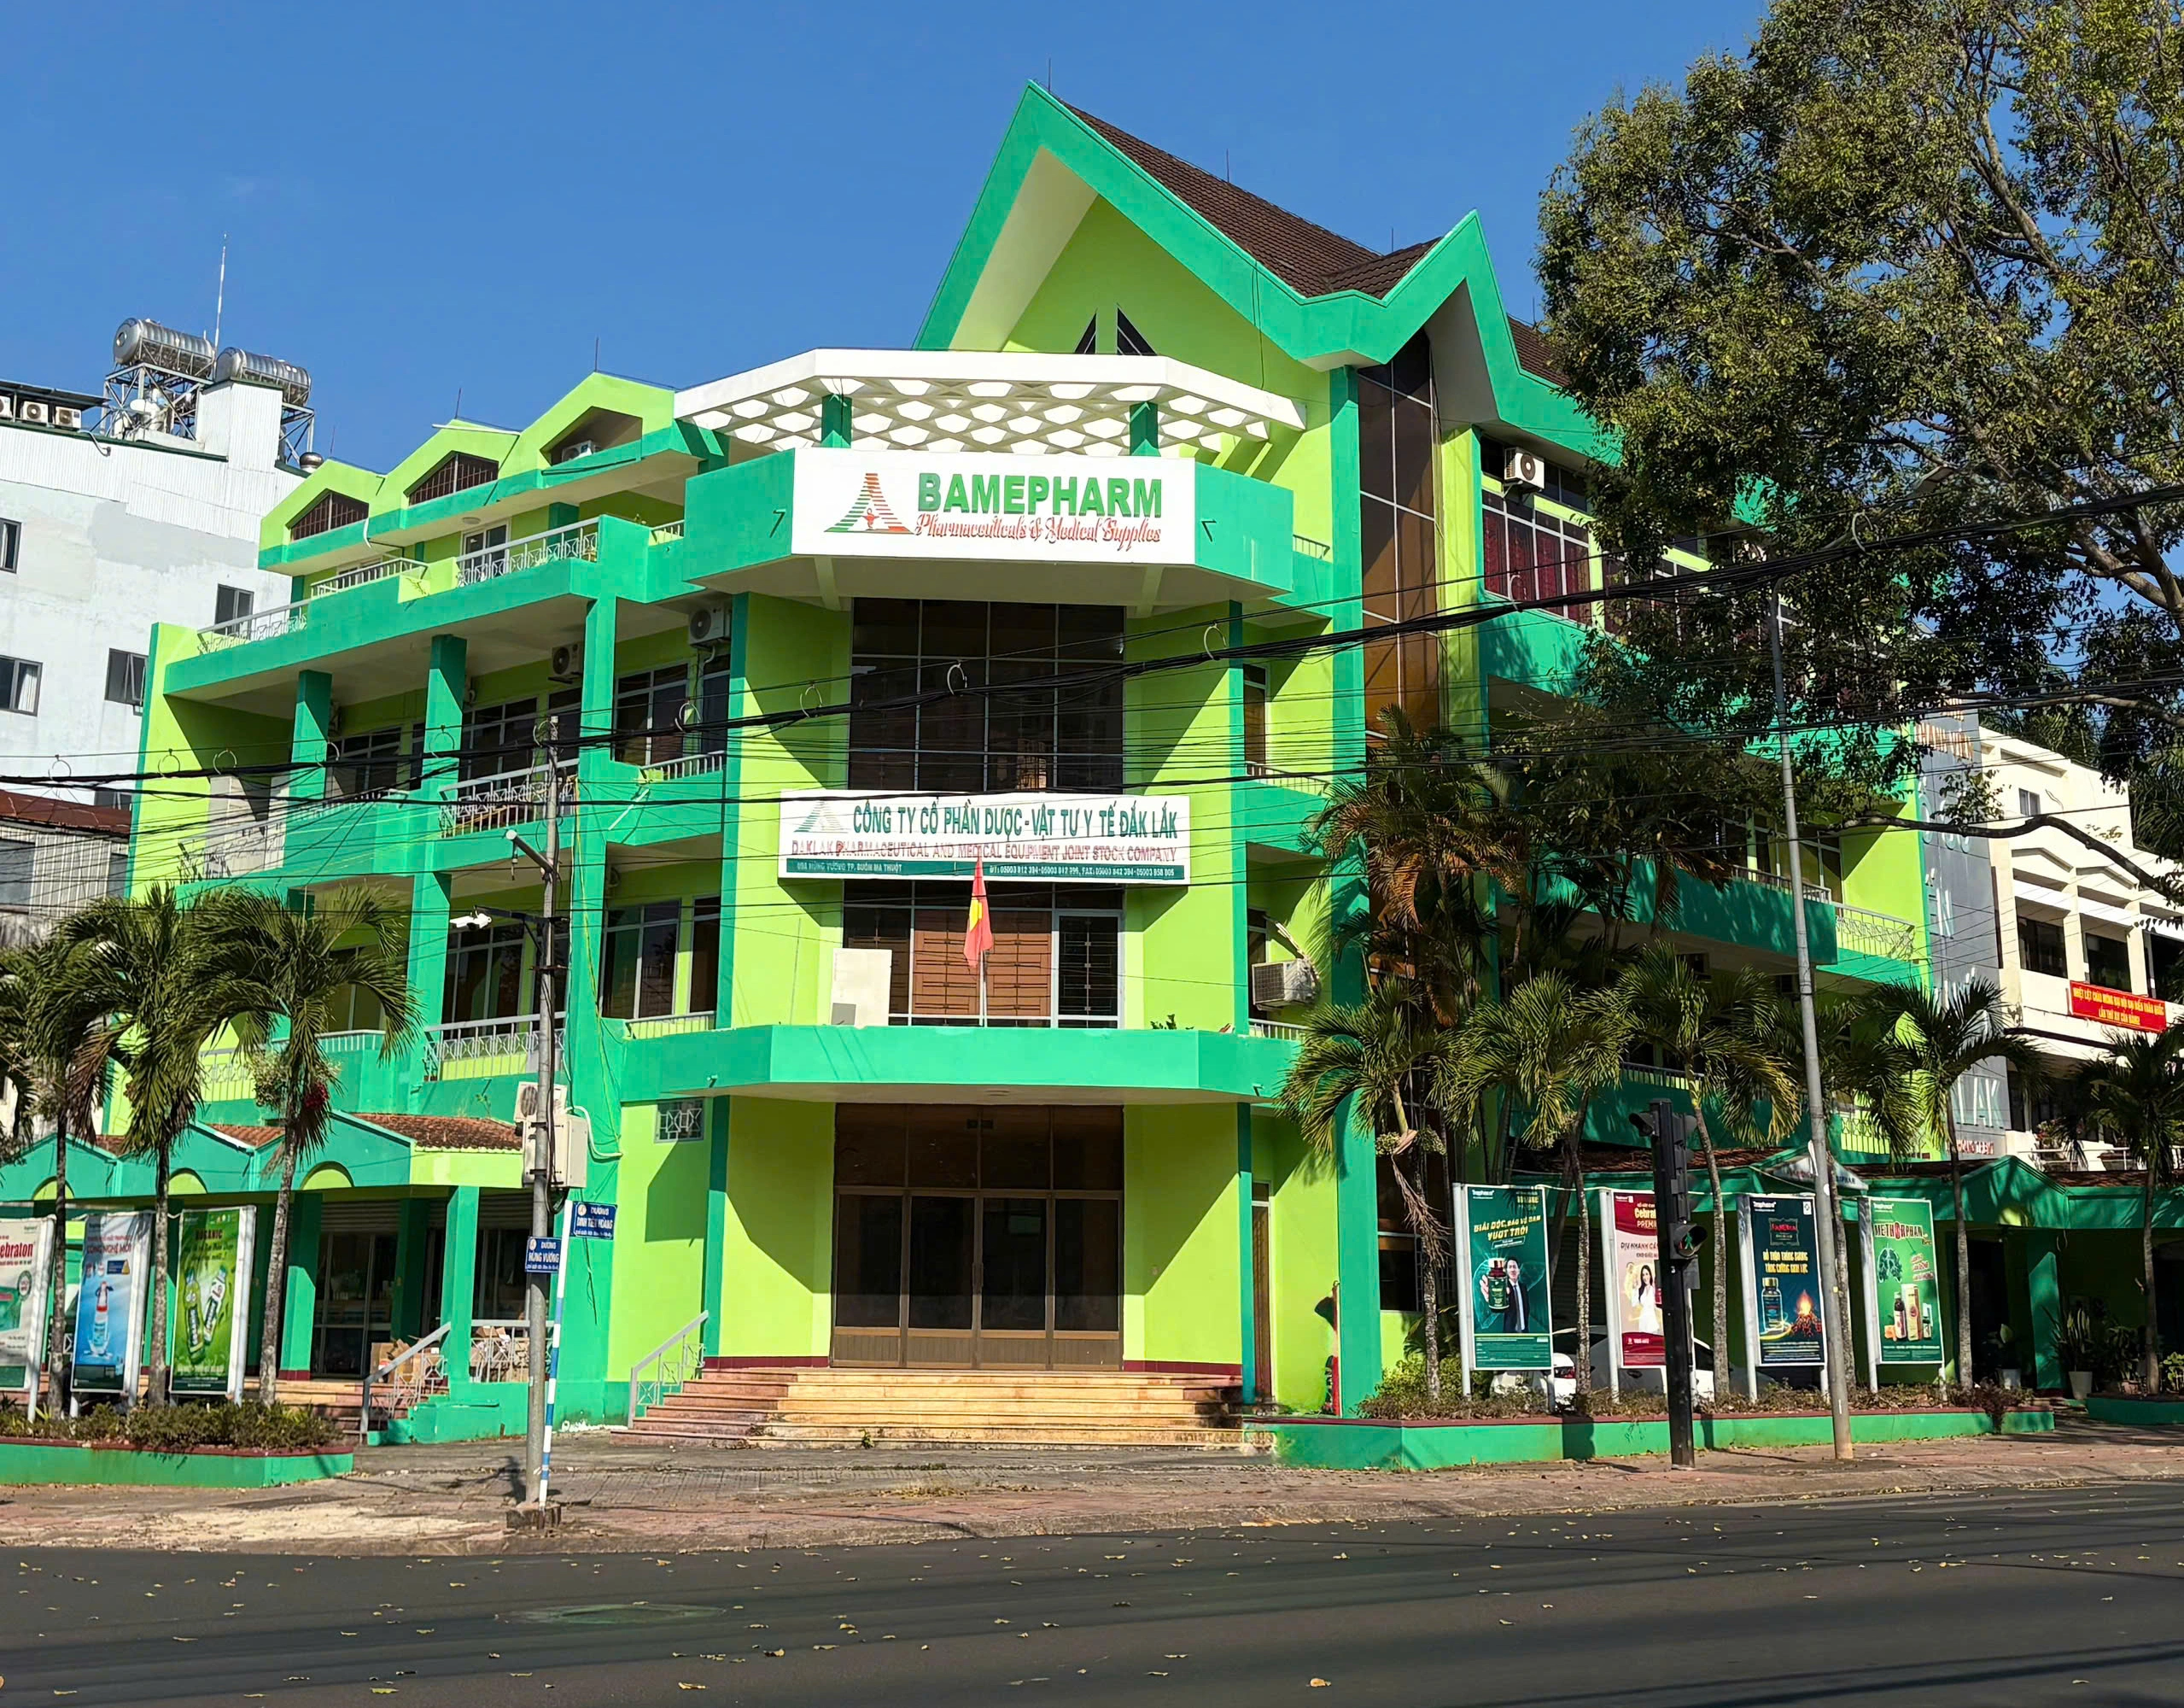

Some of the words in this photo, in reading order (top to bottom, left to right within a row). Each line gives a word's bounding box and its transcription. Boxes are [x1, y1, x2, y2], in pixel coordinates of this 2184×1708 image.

[918, 472, 1162, 518] BAMEPHARM
[914, 513, 1027, 540] Pharmaceuticals
[1029, 520, 1044, 542] &
[1045, 517, 1098, 544] Medical
[1098, 517, 1162, 552] Supplies
[854, 799, 891, 834] CÔNG
[898, 806, 916, 834] TY
[944, 799, 980, 834] PHẦN
[1060, 806, 1079, 836] TƯ
[1084, 810, 1093, 838] Y
[1100, 800, 1118, 838] TẾ
[1127, 845, 1177, 863] COMPANY
[0, 1242, 33, 1259] ebraton
